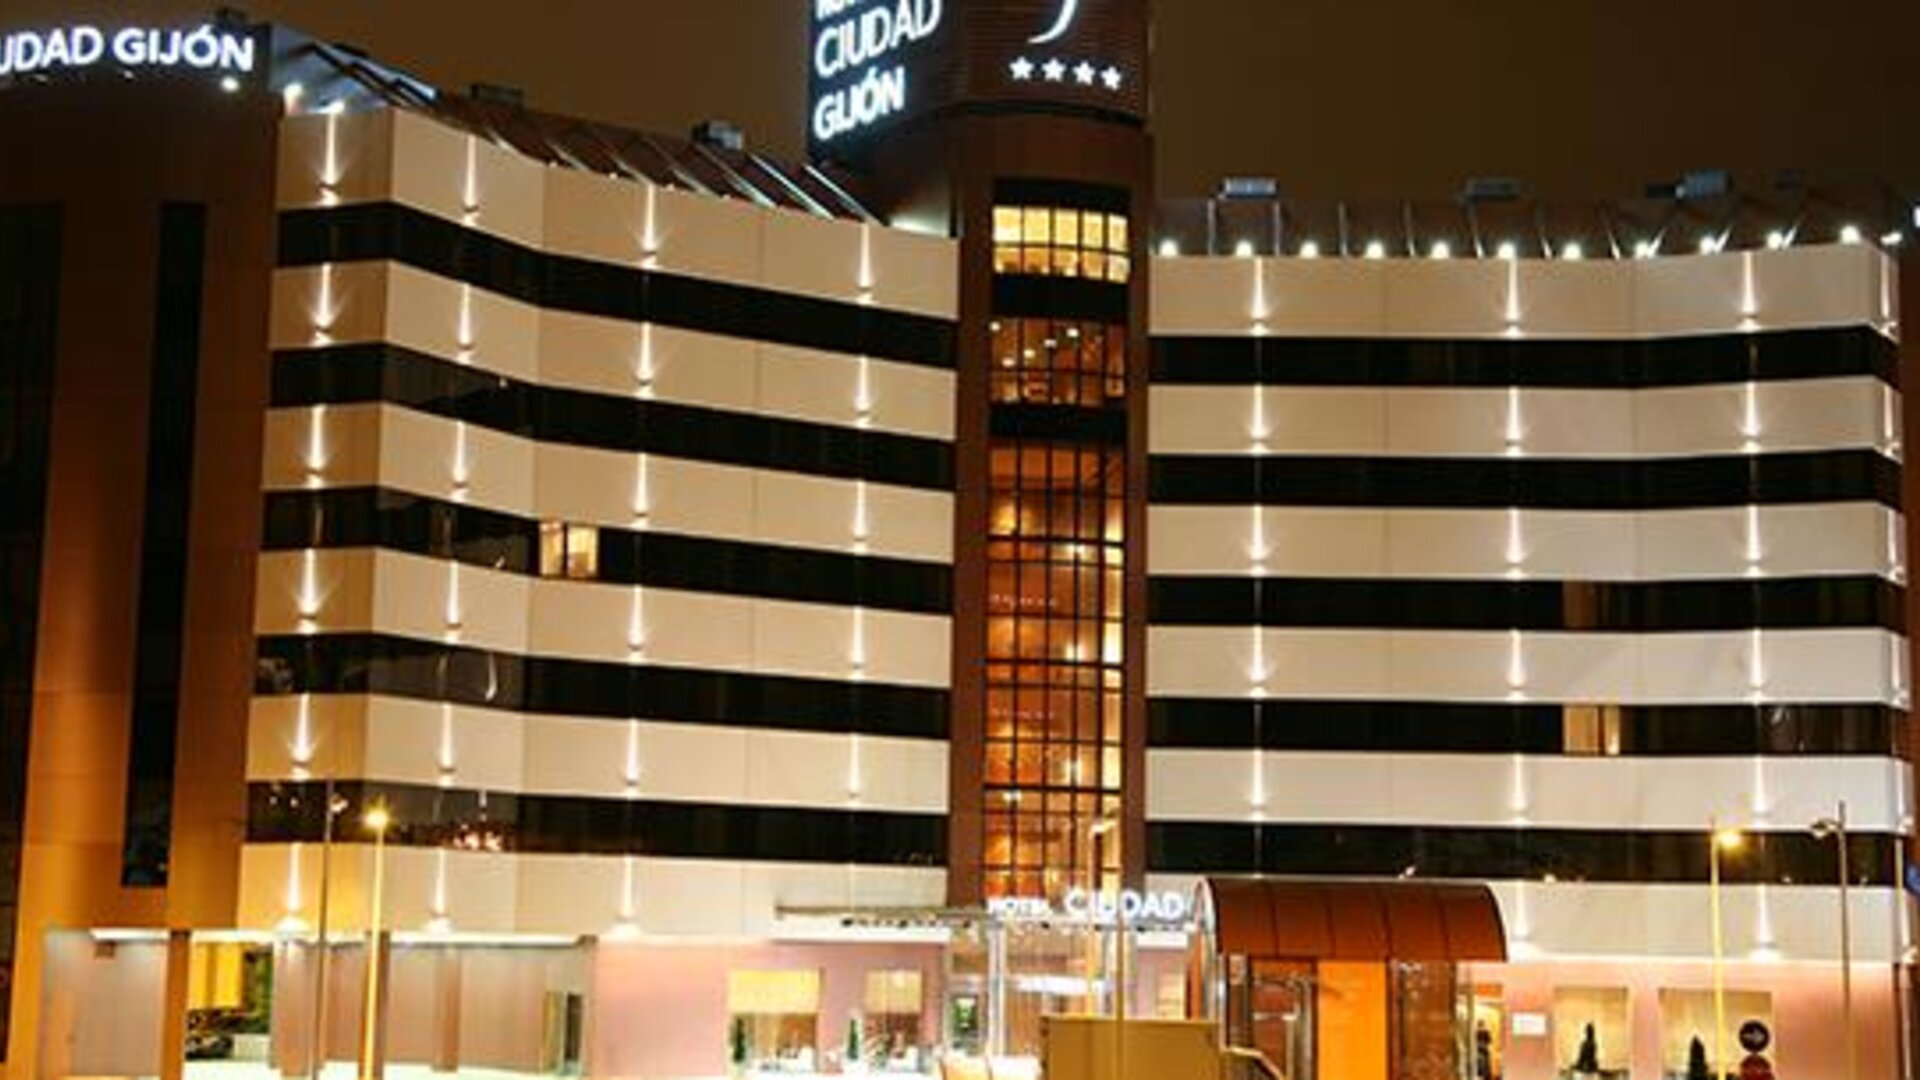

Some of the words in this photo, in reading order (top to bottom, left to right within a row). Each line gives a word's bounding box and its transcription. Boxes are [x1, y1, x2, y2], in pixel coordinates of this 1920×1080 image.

[113, 25, 254, 71] GIJÓN
[814, 0, 941, 77] CIUDAD
[813, 66, 905, 140] GIJÓN
[1065, 886, 1186, 920] CIUDAD
